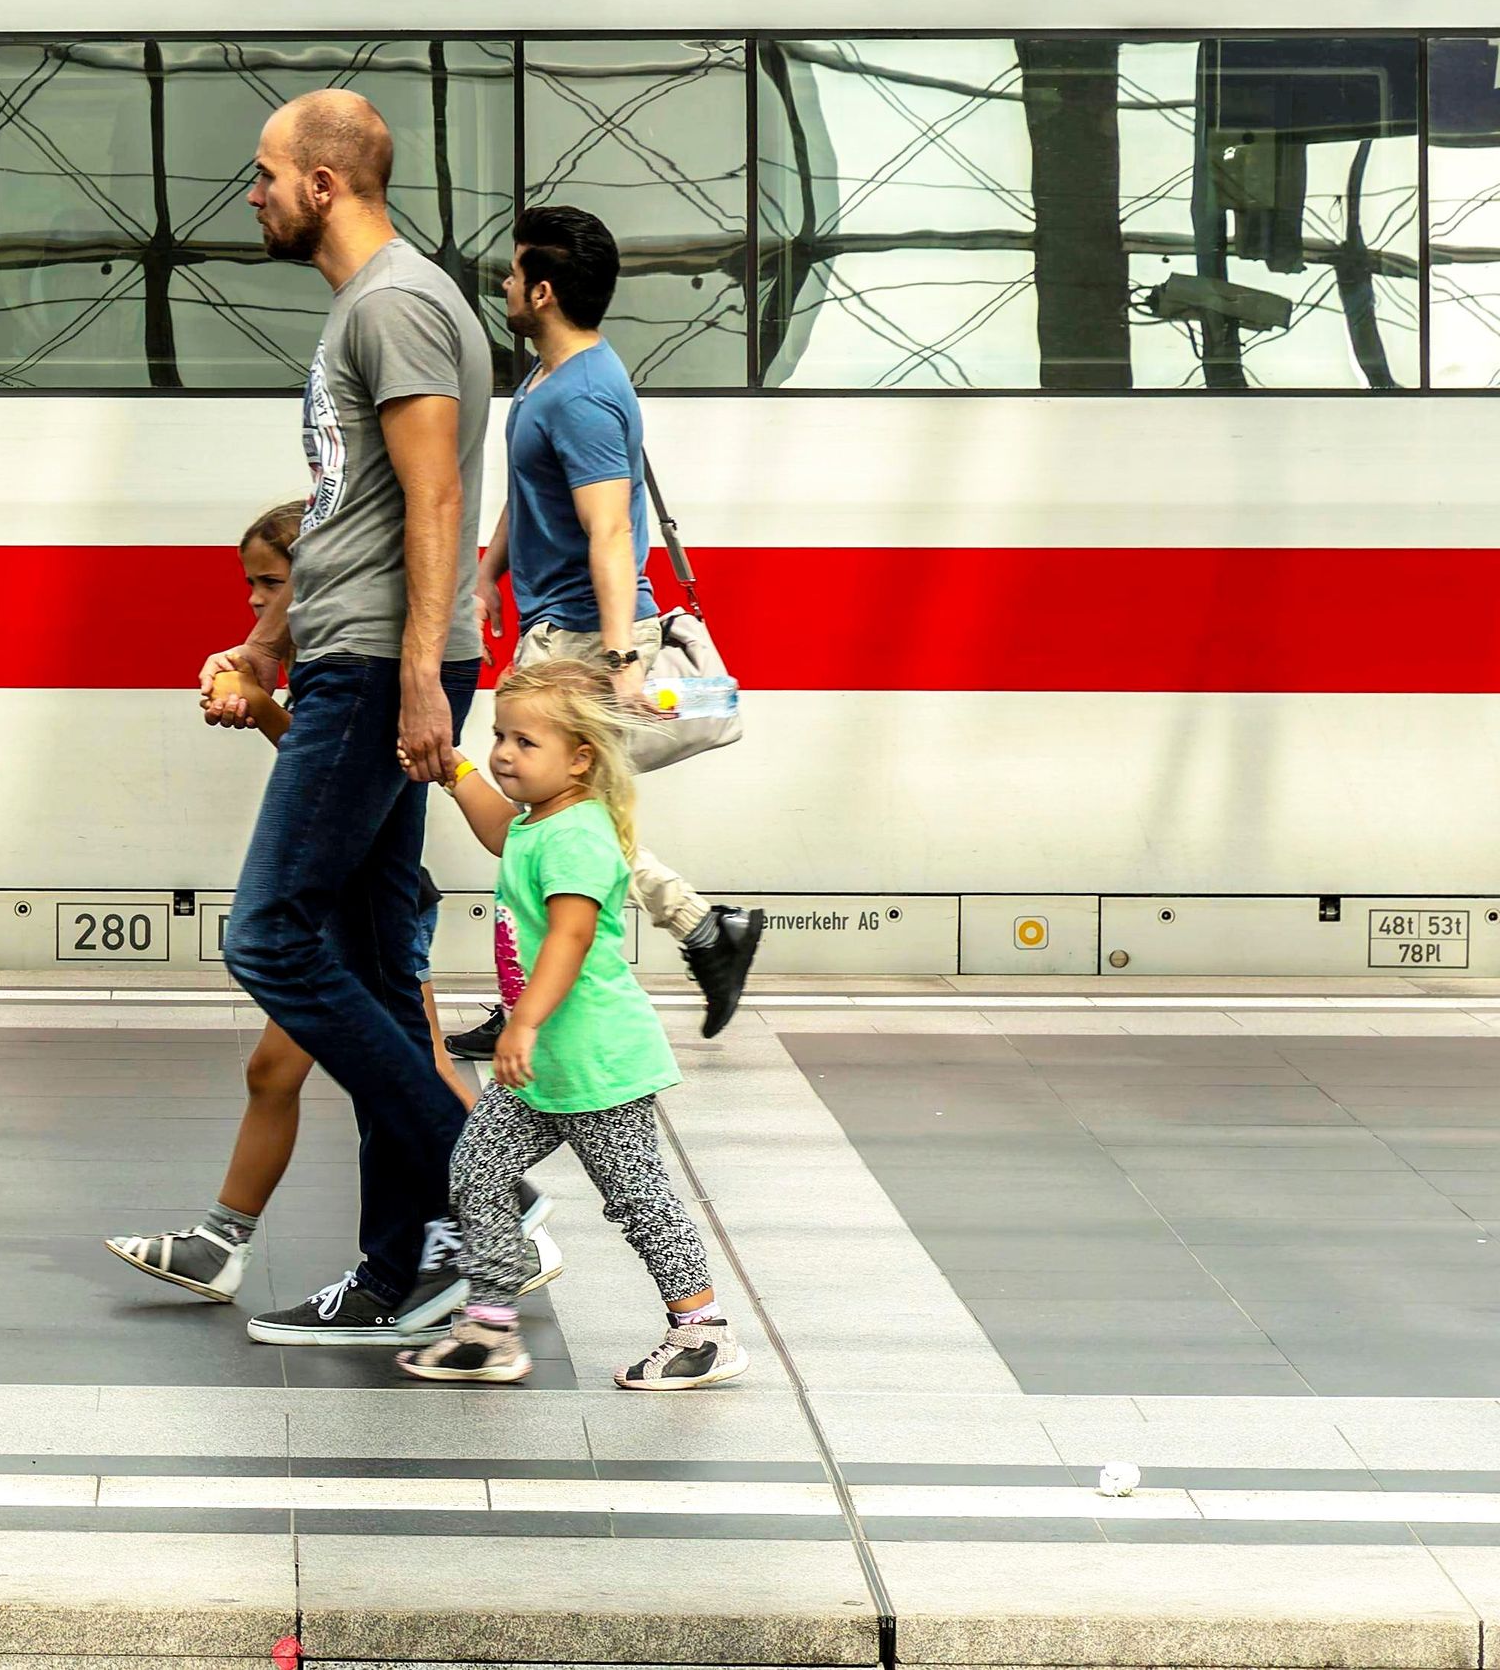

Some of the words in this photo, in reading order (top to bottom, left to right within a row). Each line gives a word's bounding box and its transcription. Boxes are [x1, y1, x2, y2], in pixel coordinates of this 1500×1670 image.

[75, 914, 151, 950] 280
[762, 911, 849, 930] ernverkehr
[858, 911, 879, 930] AG
